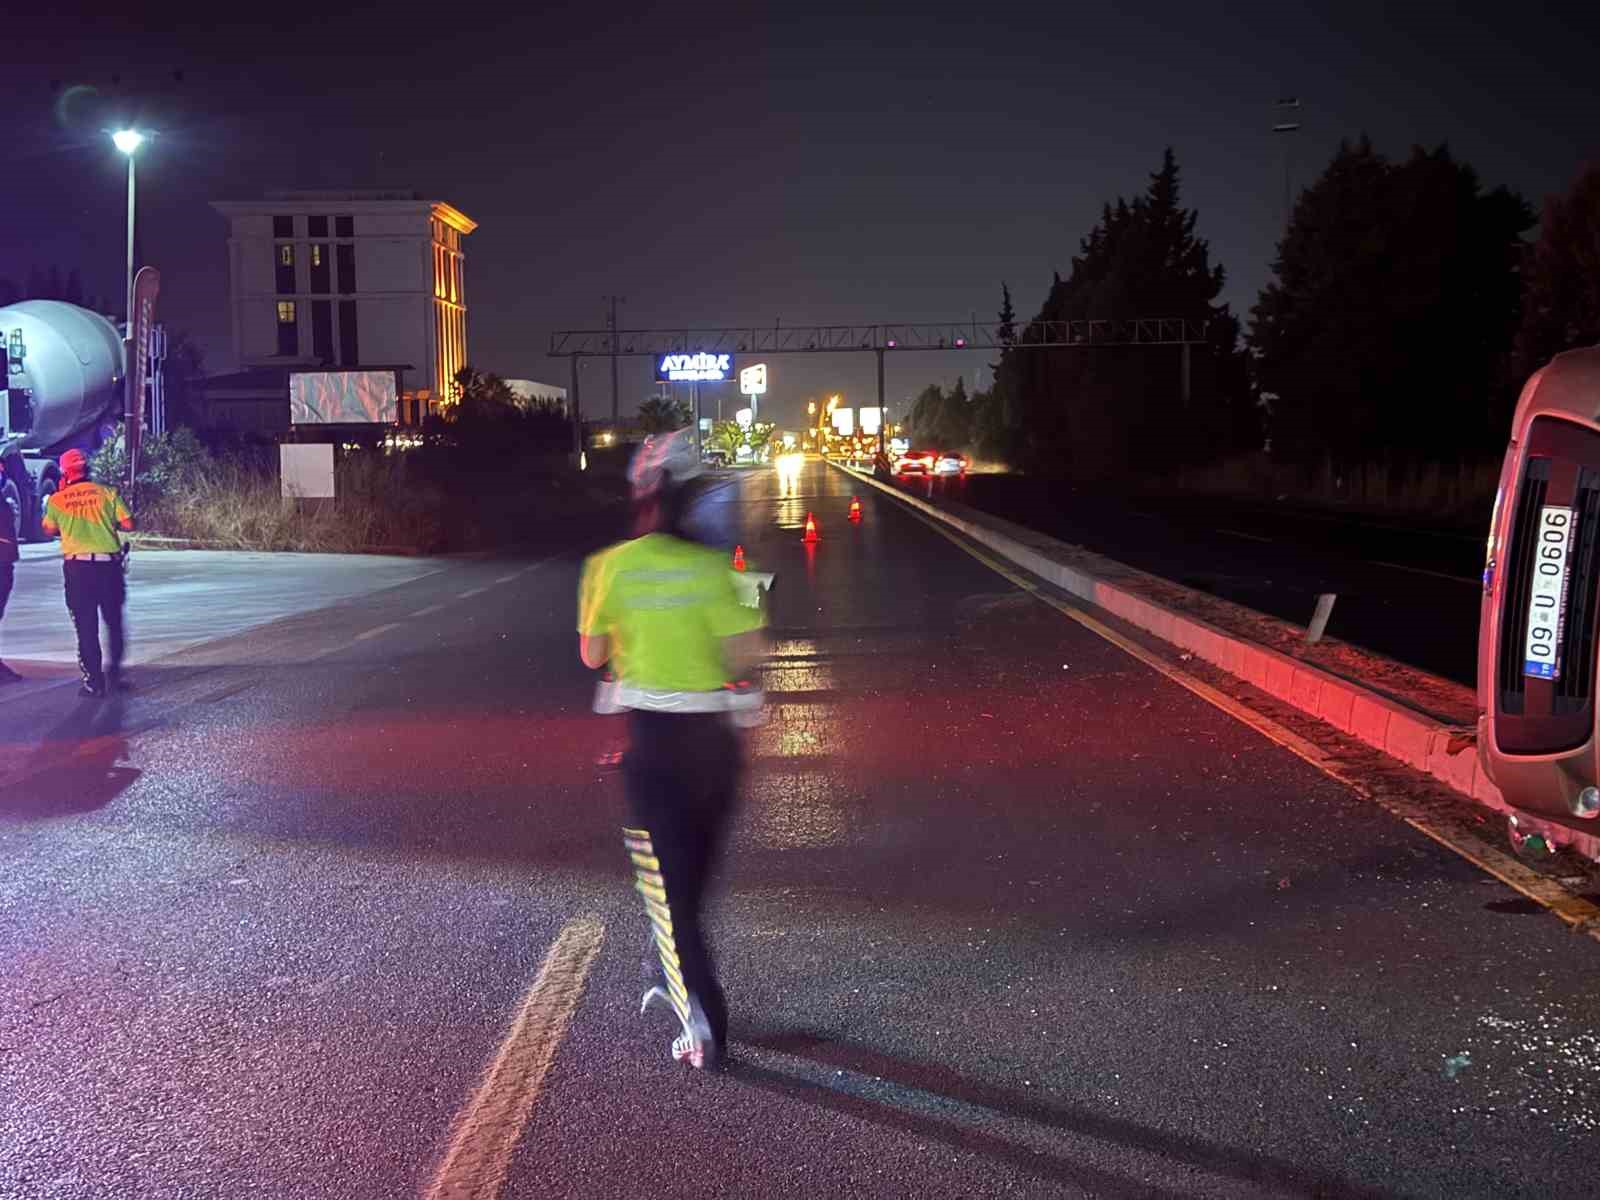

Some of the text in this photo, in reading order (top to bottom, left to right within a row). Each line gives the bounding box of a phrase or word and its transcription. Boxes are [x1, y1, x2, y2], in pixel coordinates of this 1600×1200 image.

[63, 489, 98, 500] TRAF
[1539, 513, 1567, 576] 0606
[1535, 594, 1556, 608] U
[1530, 626, 1552, 657] 09
